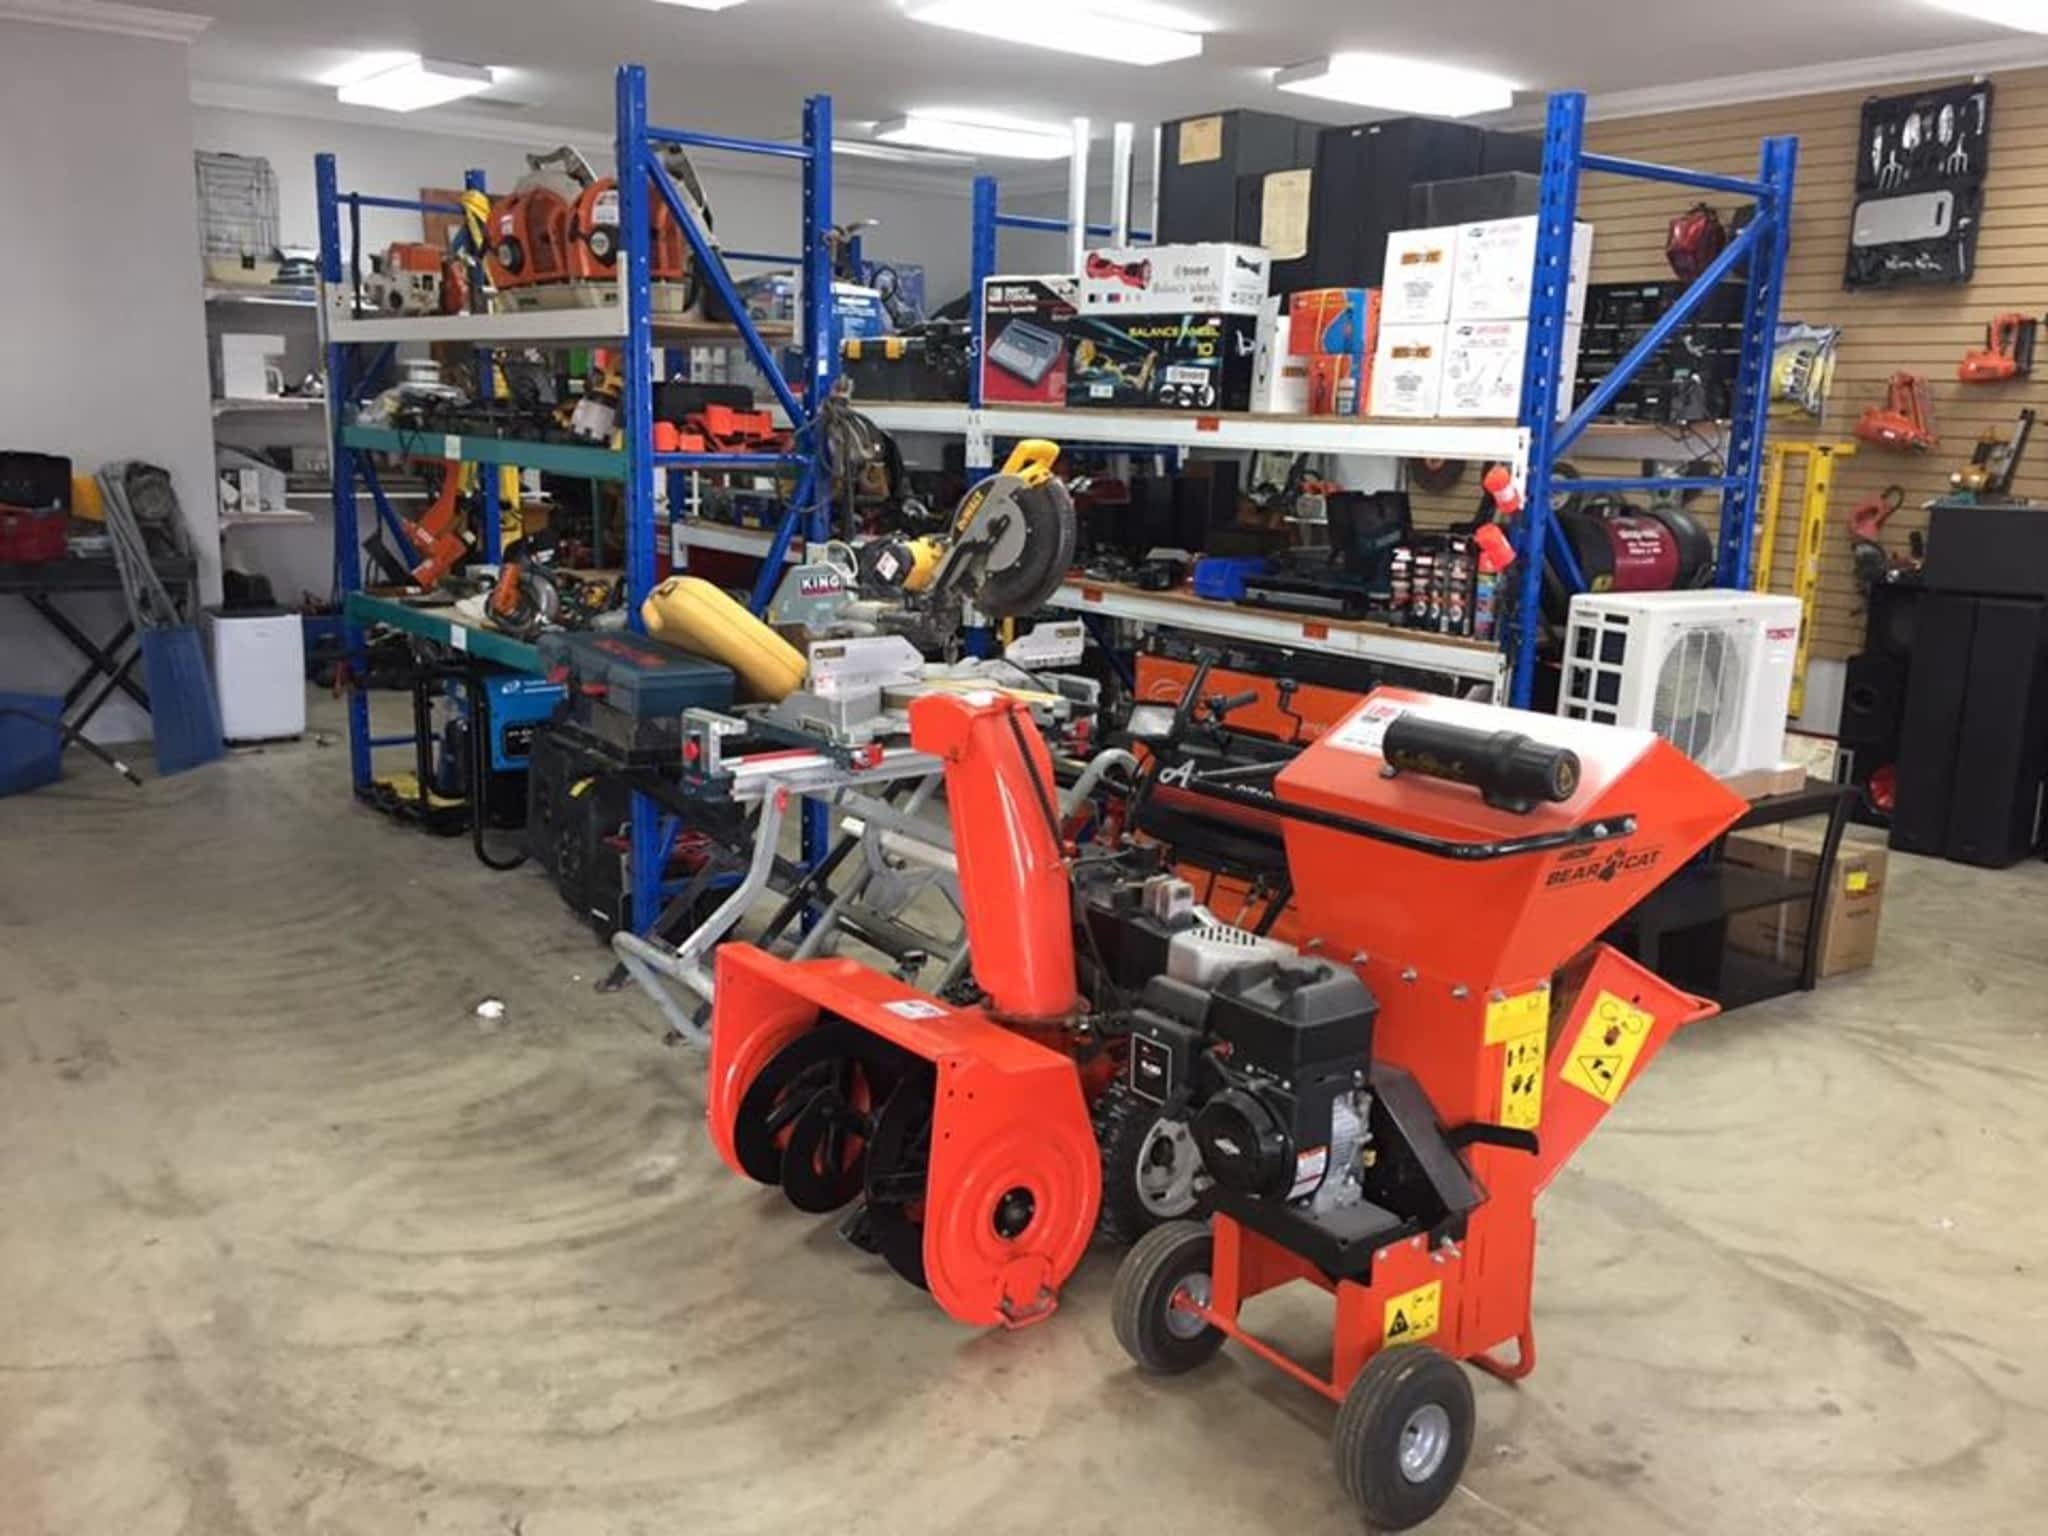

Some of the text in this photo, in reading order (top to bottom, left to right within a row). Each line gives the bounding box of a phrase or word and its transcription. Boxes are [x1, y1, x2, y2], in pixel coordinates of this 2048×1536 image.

[801, 576, 841, 588] KING
[1545, 850, 1661, 886] BEAR CAT
